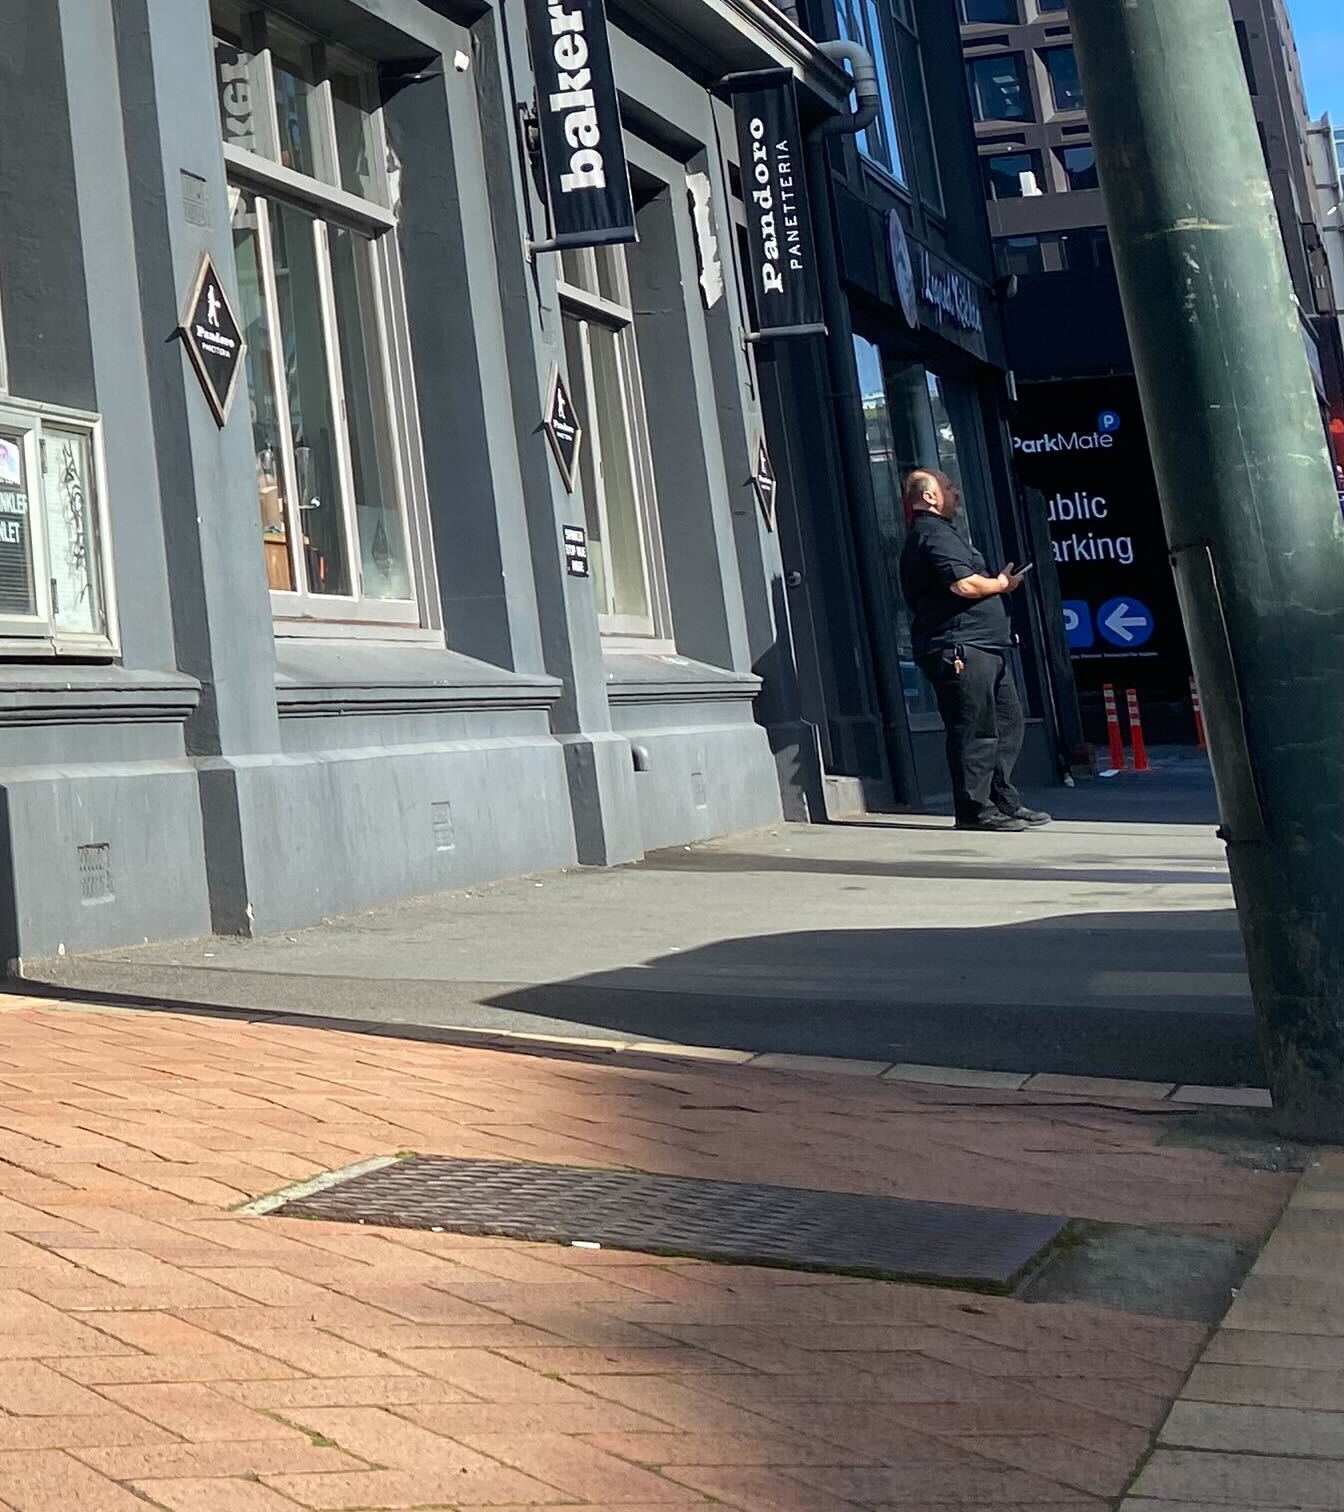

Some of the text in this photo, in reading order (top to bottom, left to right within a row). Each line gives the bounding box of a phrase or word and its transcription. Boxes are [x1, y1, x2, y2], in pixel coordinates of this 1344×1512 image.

[750, 117, 784, 295] Pandoro
[775, 139, 803, 270] PANETTERIA
[1103, 414, 1114, 428] P
[1047, 491, 1108, 521] blic
[1052, 533, 1133, 564] arking
